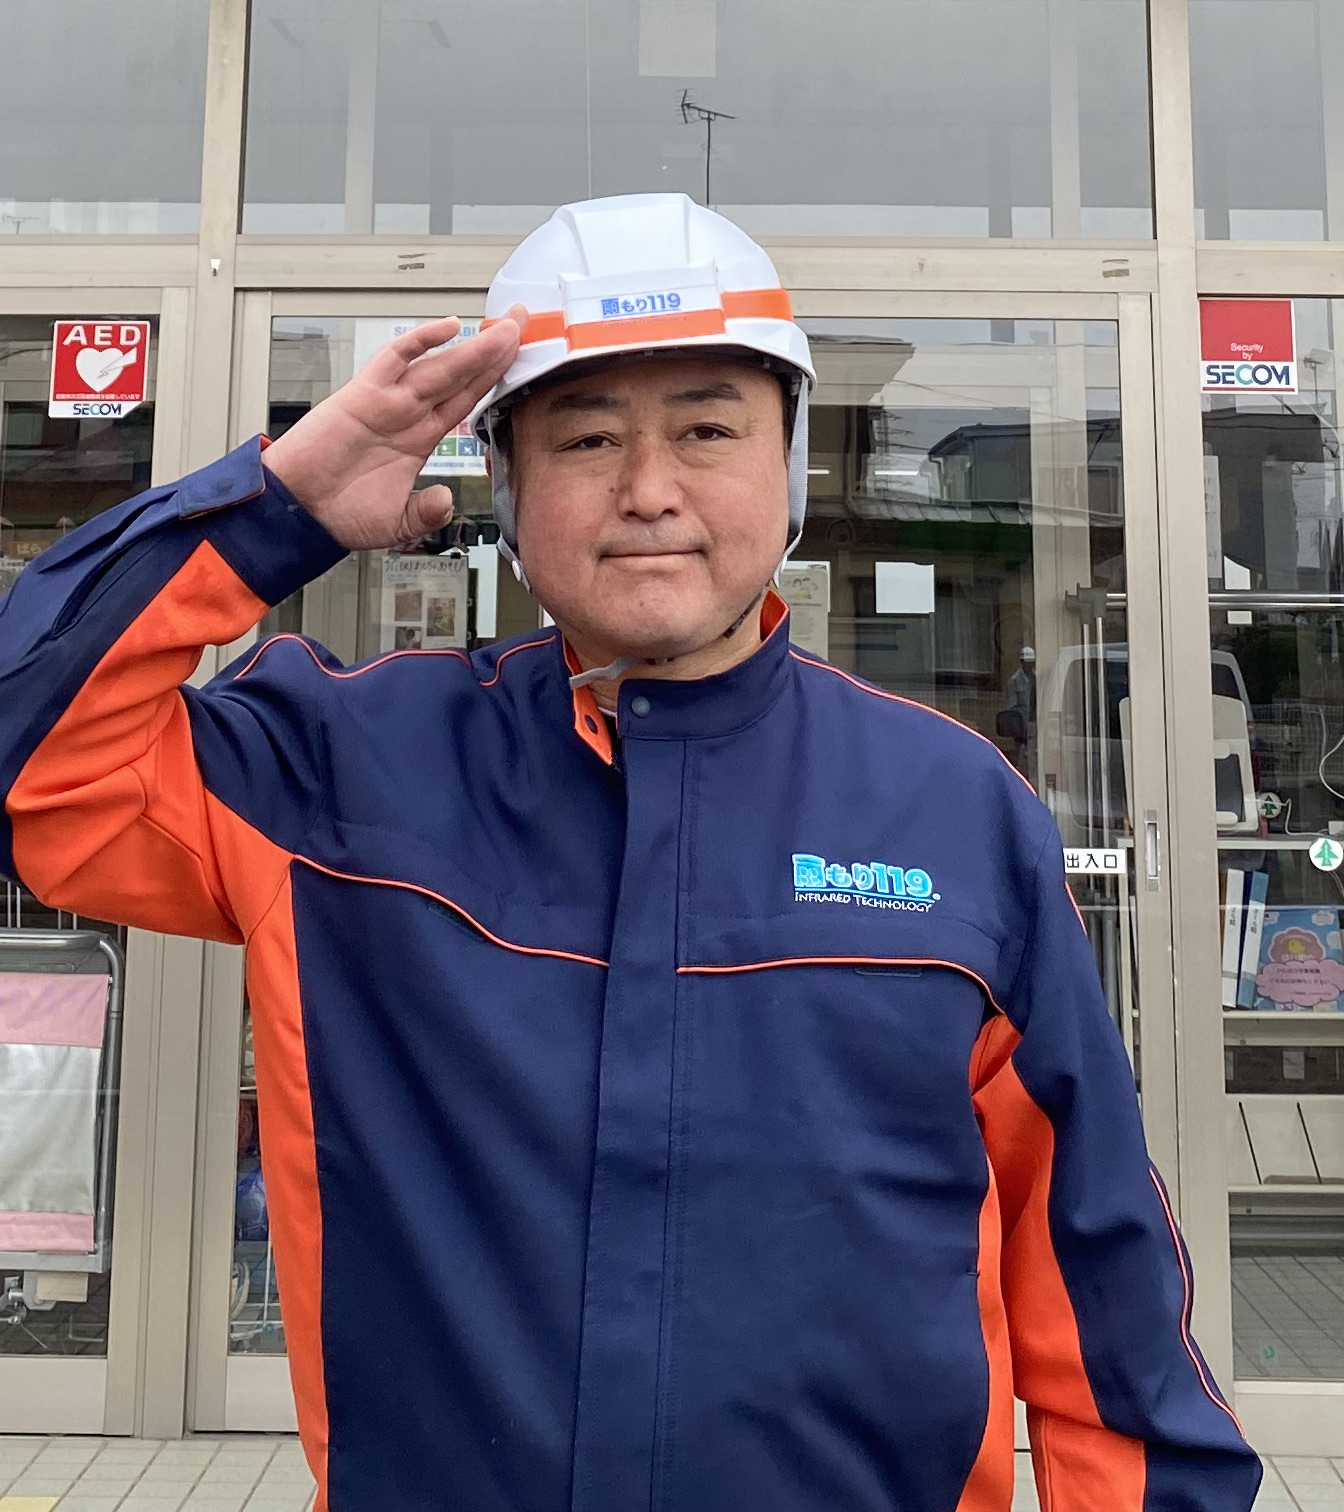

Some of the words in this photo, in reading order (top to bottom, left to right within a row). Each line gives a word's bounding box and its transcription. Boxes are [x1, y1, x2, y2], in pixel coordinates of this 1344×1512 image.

[600, 292, 681, 317] 雨もり119
[62, 325, 141, 346] AED
[1230, 342, 1264, 354] Security
[1242, 351, 1254, 361] by
[1205, 364, 1291, 386] SECOM
[72, 403, 123, 416] SECOM
[1066, 852, 1118, 869] 出入口
[792, 854, 933, 898] 雨もり119
[794, 891, 851, 904] INFRARED
[853, 894, 933, 913] TECHNOLOGY
